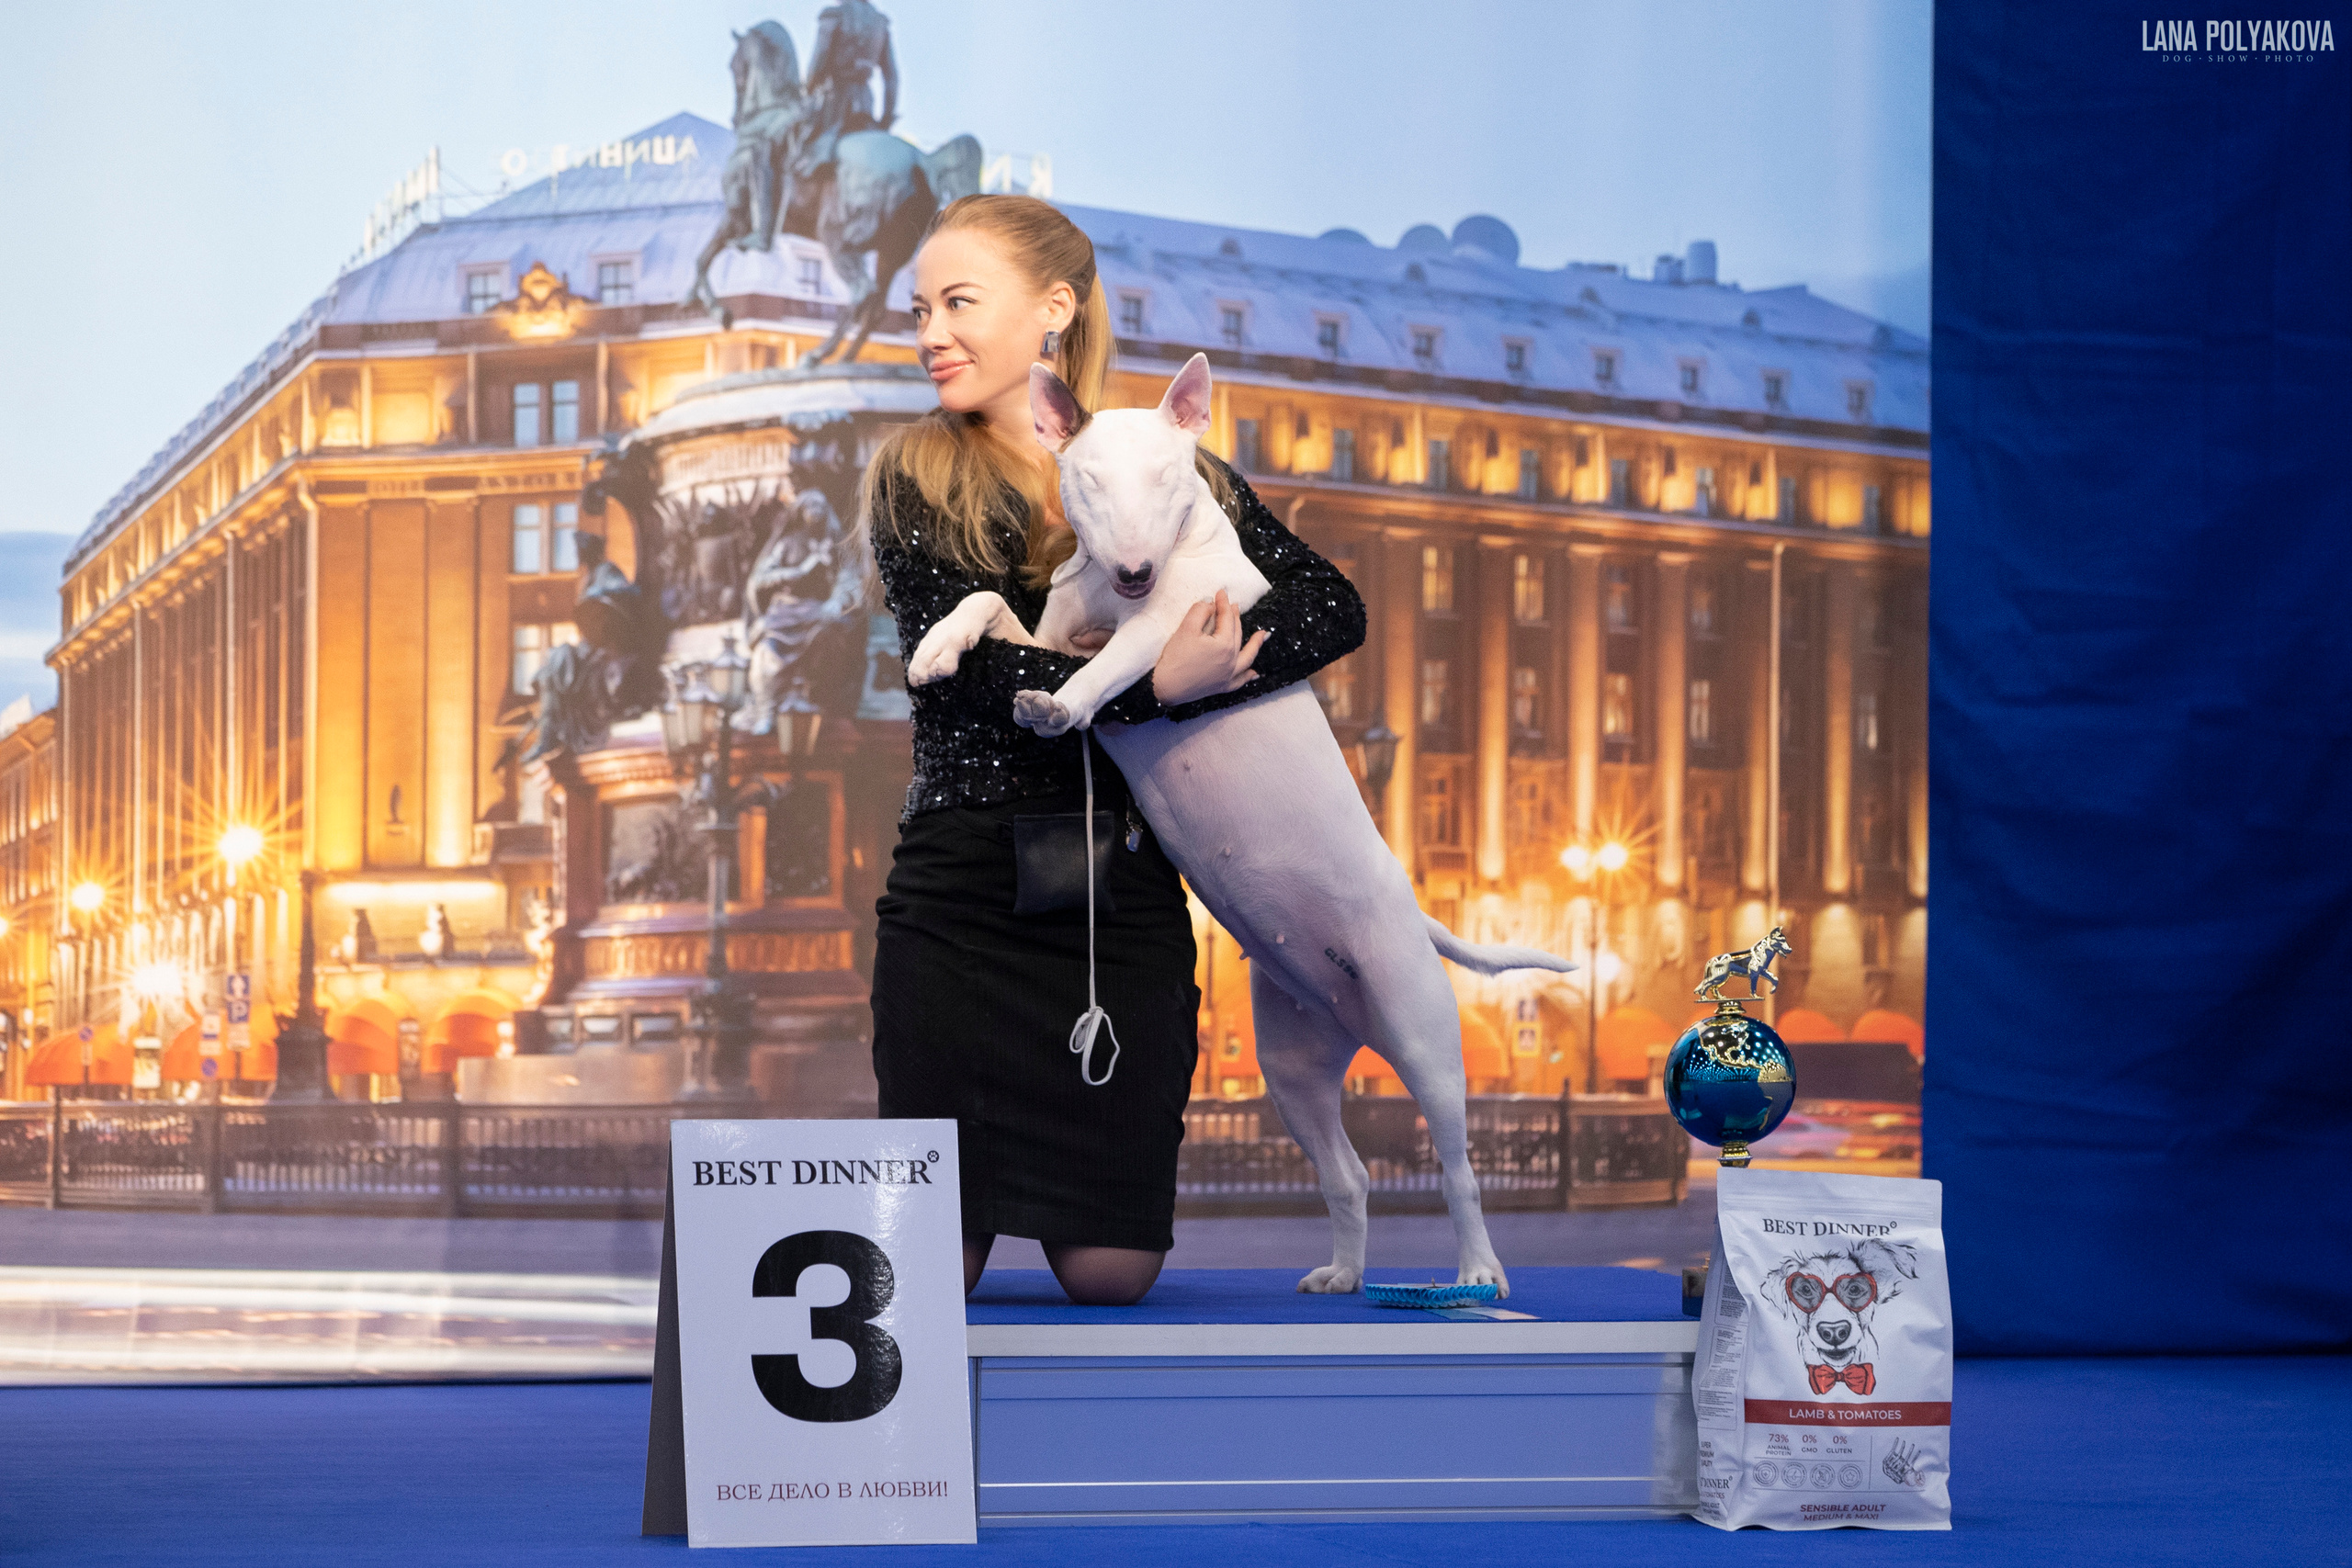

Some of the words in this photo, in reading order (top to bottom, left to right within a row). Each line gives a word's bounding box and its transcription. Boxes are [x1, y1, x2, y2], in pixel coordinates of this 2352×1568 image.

[692, 1160, 782, 1186] BEST
[791, 1159, 933, 1185] DINNER
[1762, 1218, 1808, 1236] BEST
[1813, 1222, 1890, 1236] DINNER
[751, 1229, 903, 1423] 3
[1789, 1408, 1825, 1419] LAMB
[1827, 1410, 1836, 1420] &
[1838, 1409, 1902, 1420] TOMATOES
[1769, 1433, 1790, 1443] 73%
[1802, 1434, 1817, 1444] 0%
[1832, 1435, 1848, 1445] 0%
[717, 1483, 763, 1501] ВСЕ
[768, 1483, 831, 1503] ДЕЛО
[838, 1482, 853, 1498] В
[859, 1481, 948, 1498] ЛЮБВИ!
[1800, 1504, 1850, 1513] SENSIBLE
[1851, 1504, 1887, 1512] ADULT
[1804, 1513, 1844, 1522] MEDIUM
